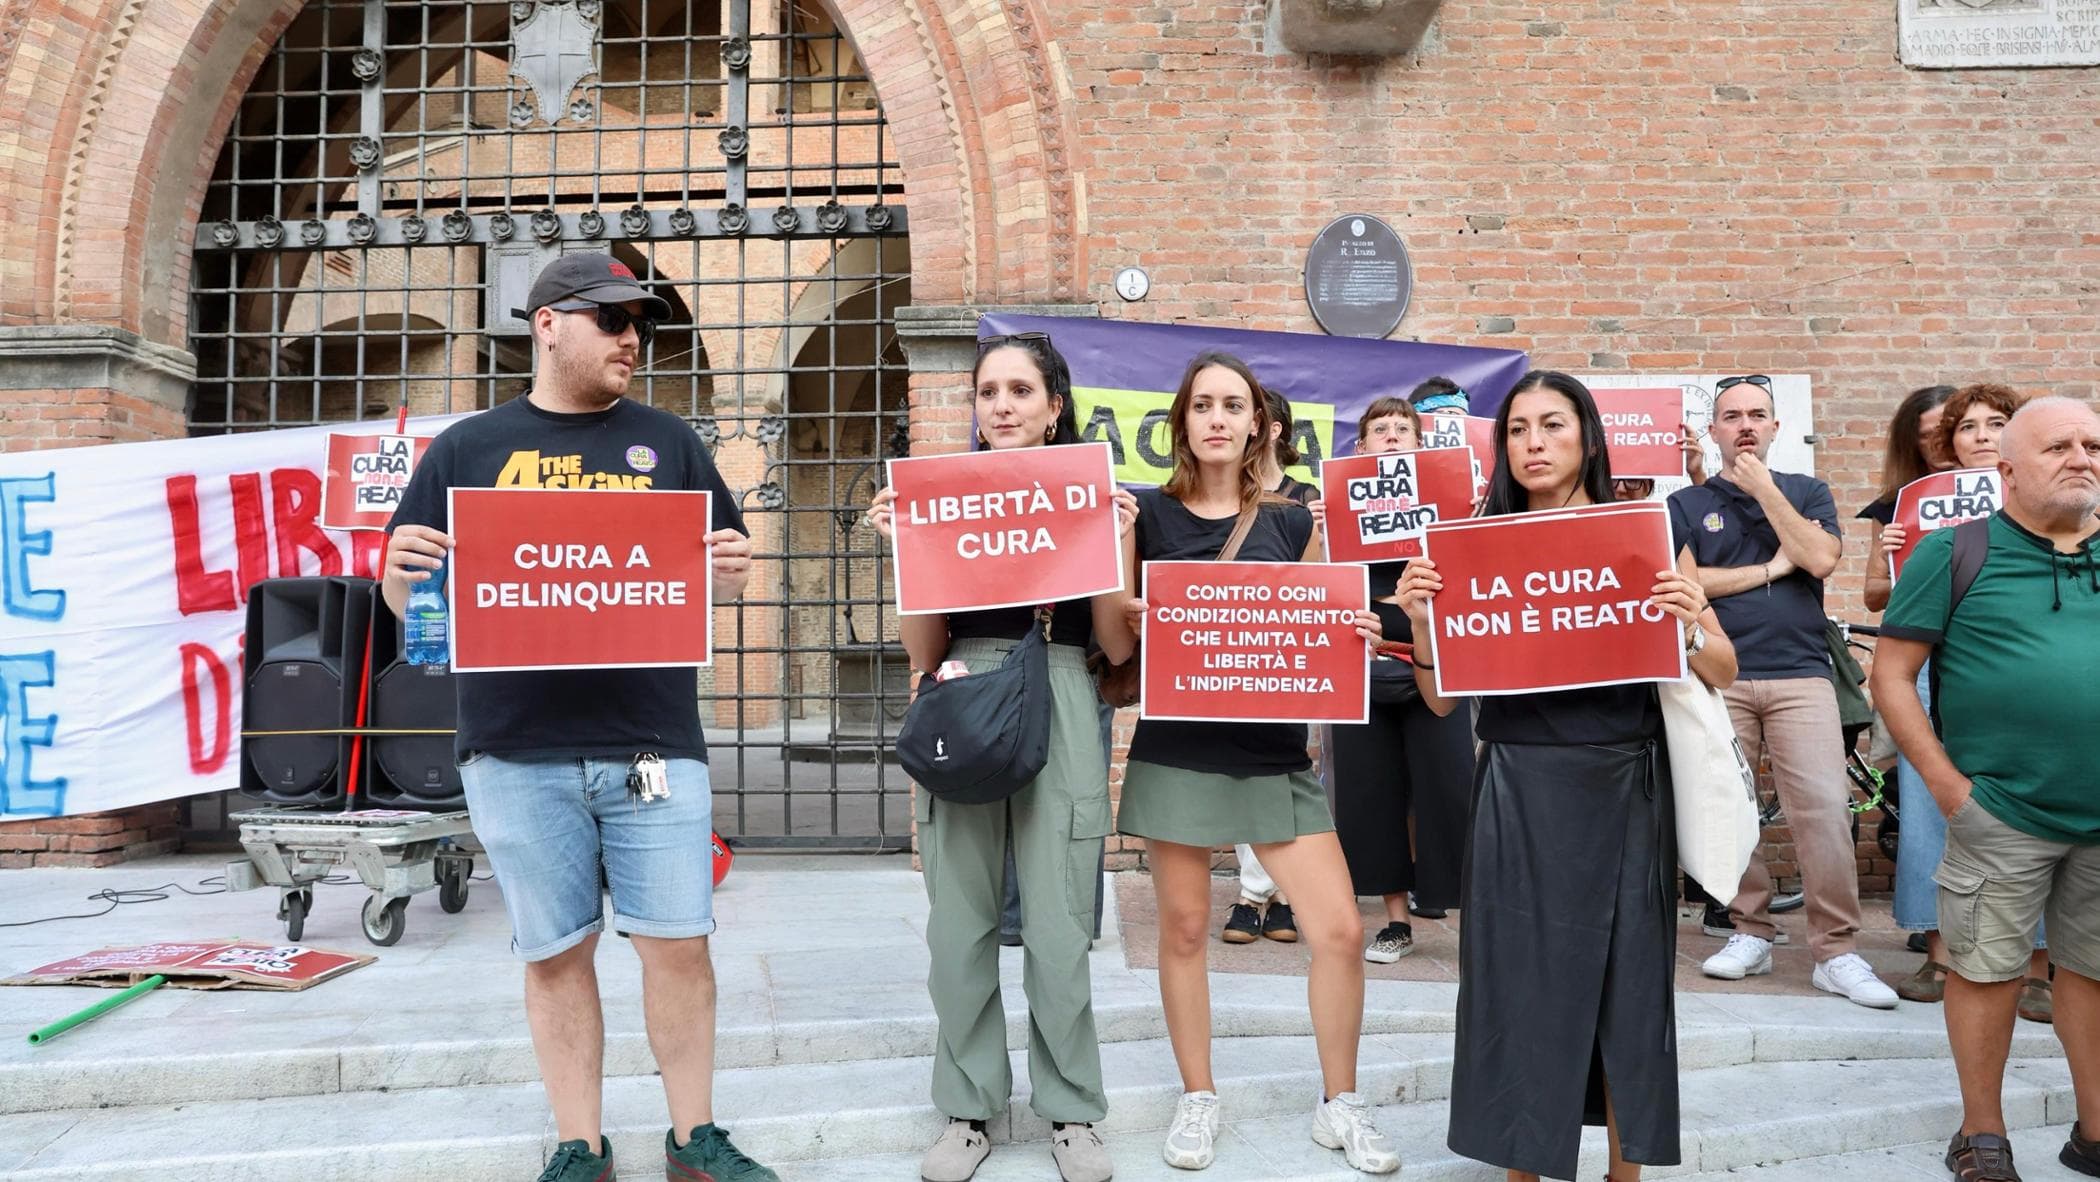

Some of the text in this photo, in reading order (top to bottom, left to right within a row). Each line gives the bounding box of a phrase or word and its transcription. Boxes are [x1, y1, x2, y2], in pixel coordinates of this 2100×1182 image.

[1128, 286, 1137, 297] C
[1435, 418, 1461, 436] LA
[1600, 413, 1654, 427] CURA
[380, 439, 409, 458] LA
[1423, 434, 1461, 449] URA
[1614, 431, 1678, 446] REATO
[353, 456, 408, 475] CURA
[540, 454, 582, 476] THE
[1379, 458, 1411, 479] LA
[1350, 478, 1413, 501] CURA
[1956, 475, 1995, 497] LA
[909, 480, 1097, 525] LIBERTÀ DI
[1920, 495, 1995, 520] CURA
[1361, 507, 1436, 537] REATO
[957, 527, 1057, 560] CURA
[514, 543, 651, 570] CURA A
[1186, 584, 1327, 602] CONTRO OGNI
[1470, 566, 1621, 600] LA CURA
[476, 581, 687, 613] DELINQUERE
[1157, 607, 1356, 625] CONDIZIONAMENTO
[1445, 598, 1665, 638] NON È REATO
[1180, 630, 1331, 647] CHE LIMITA LA
[1203, 650, 1307, 670] LIBERTÀ E
[1174, 676, 1335, 693] L'INDIPENDENZA
